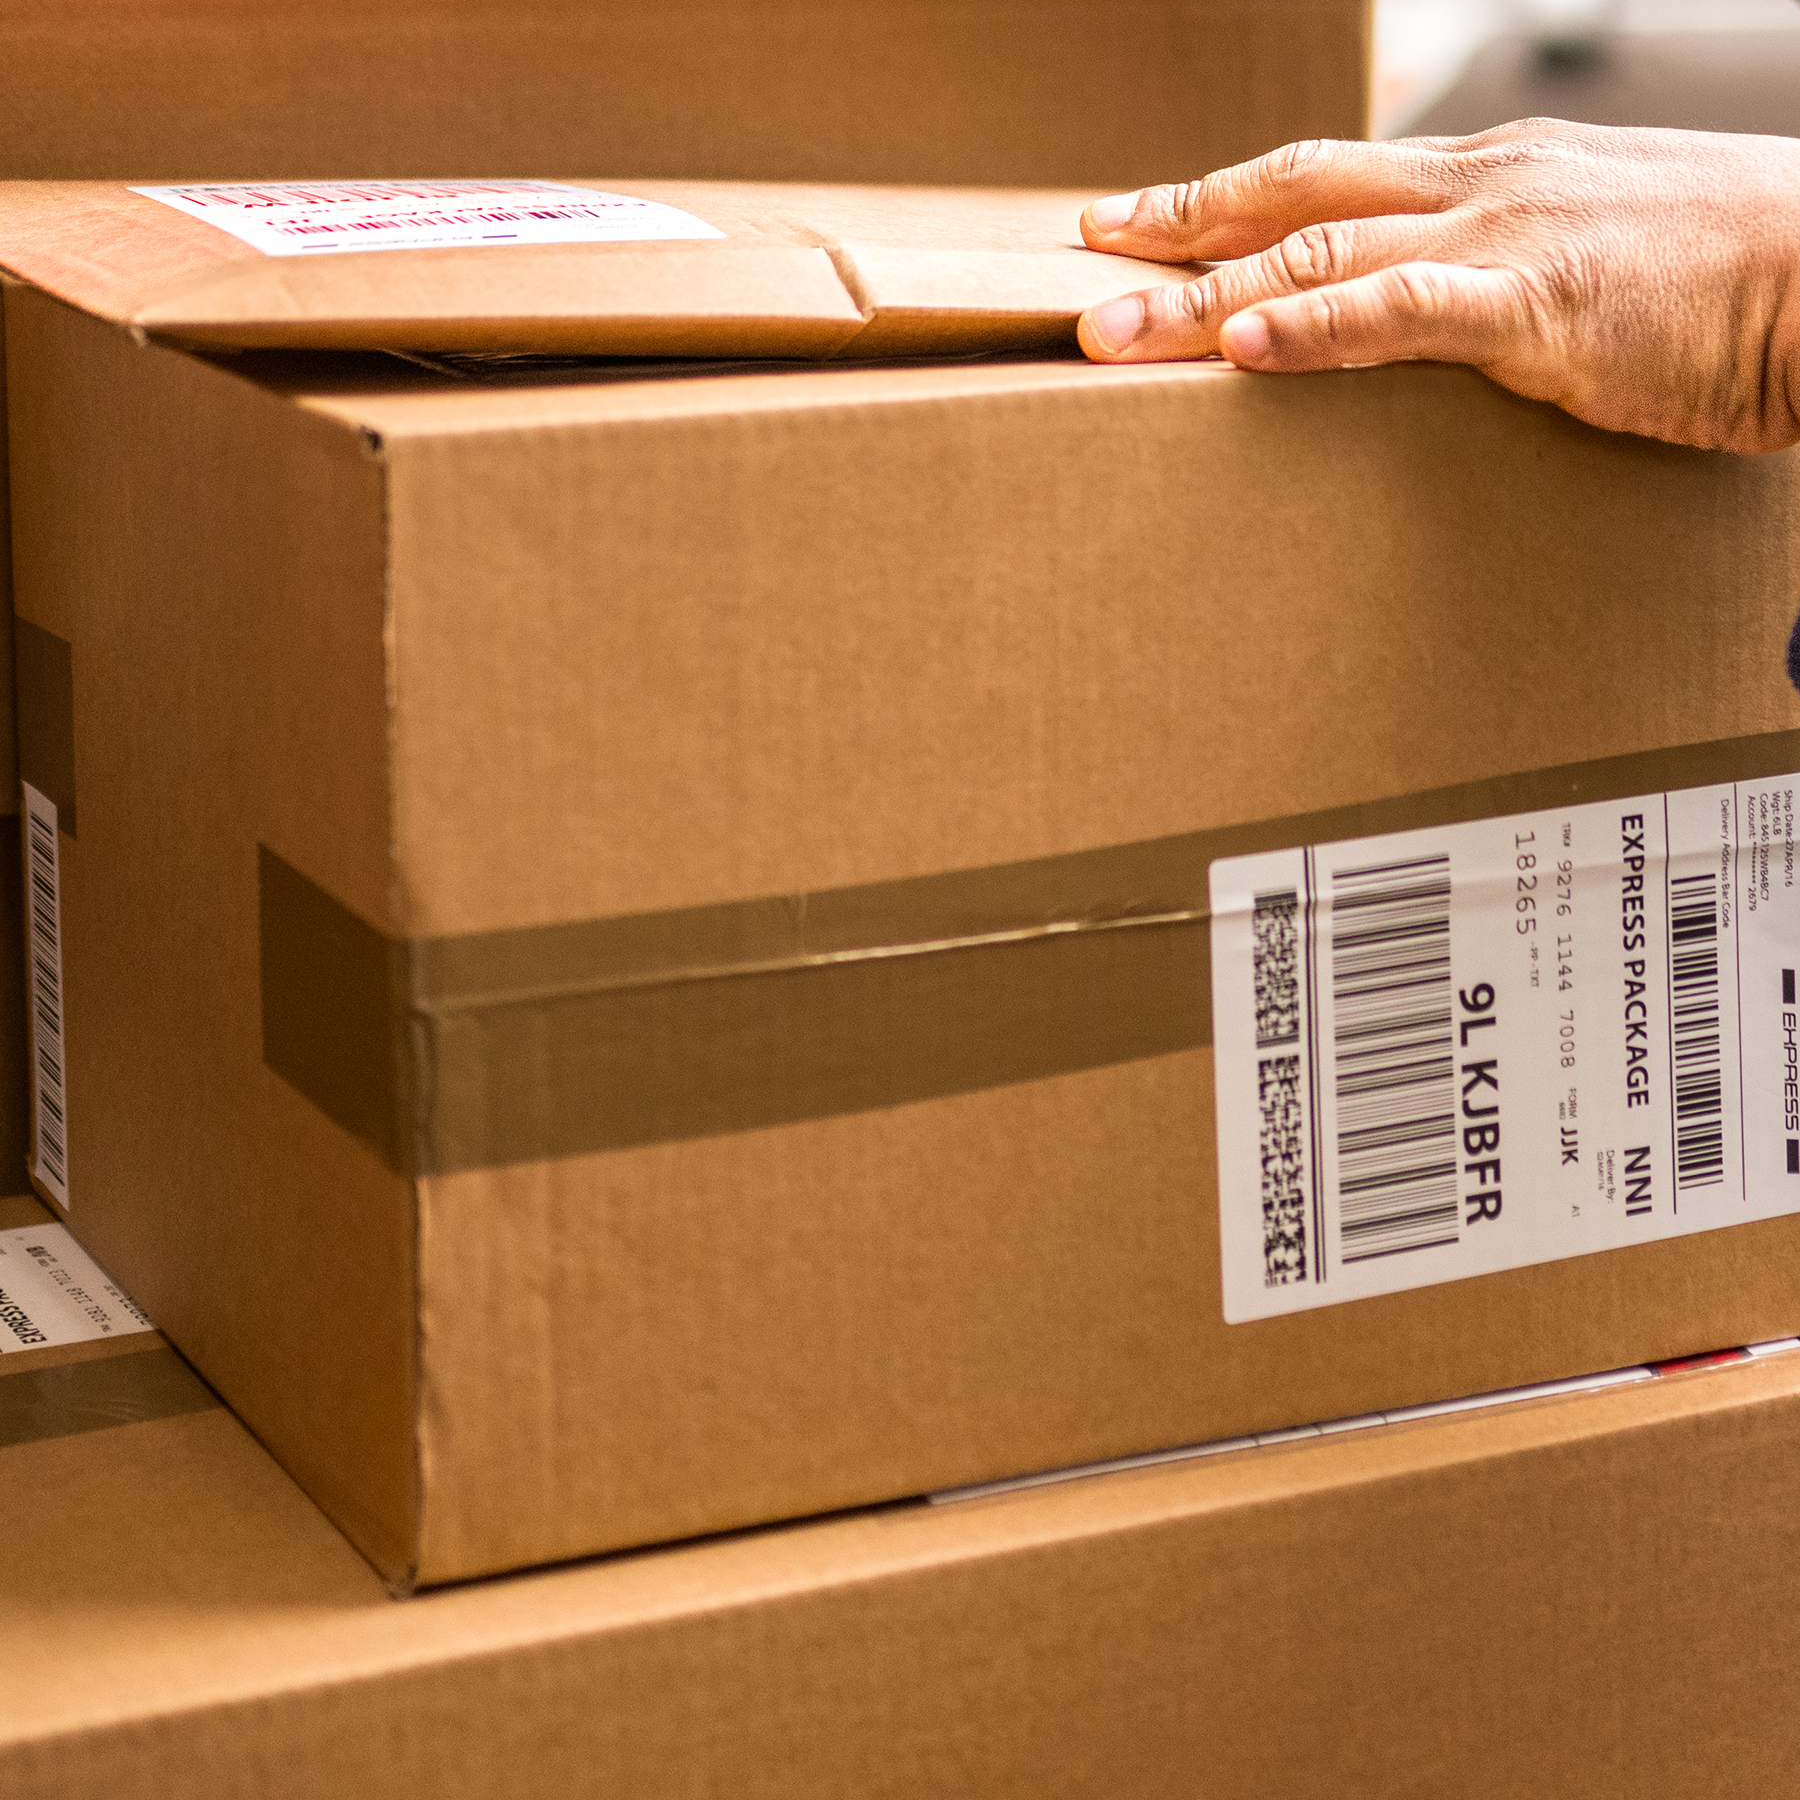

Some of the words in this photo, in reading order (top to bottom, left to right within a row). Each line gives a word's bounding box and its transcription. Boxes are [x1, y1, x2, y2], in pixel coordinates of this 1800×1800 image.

[1720, 798, 1731, 840] Delivery
[1747, 795, 1758, 840] Account:
[1759, 793, 1769, 823] Code:
[1770, 791, 1781, 815] Wgt:
[1783, 789, 1794, 812] Ship
[1514, 830, 1538, 936] 18265
[1621, 812, 1647, 951] EXPRESS
[1721, 842, 1731, 882] Address
[1556, 859, 1573, 917] 9276
[1722, 883, 1732, 900] Bar
[1747, 887, 1757, 912] 2679
[1722, 901, 1732, 929] Code
[1557, 933, 1574, 993] 1144
[1459, 982, 1496, 1048] 9L
[1623, 957, 1651, 1109] PACKAGE
[1558, 1008, 1576, 1069] 7008
[1782, 1011, 1800, 1132] EXPRESS
[1568, 1088, 1578, 1119] FORM
[1460, 1058, 1503, 1227] KJBFR
[1560, 1126, 1580, 1167] JJK
[1605, 1149, 1616, 1185] Deliver
[1623, 1144, 1653, 1218] NNI
[1604, 1187, 1617, 1205] By:
